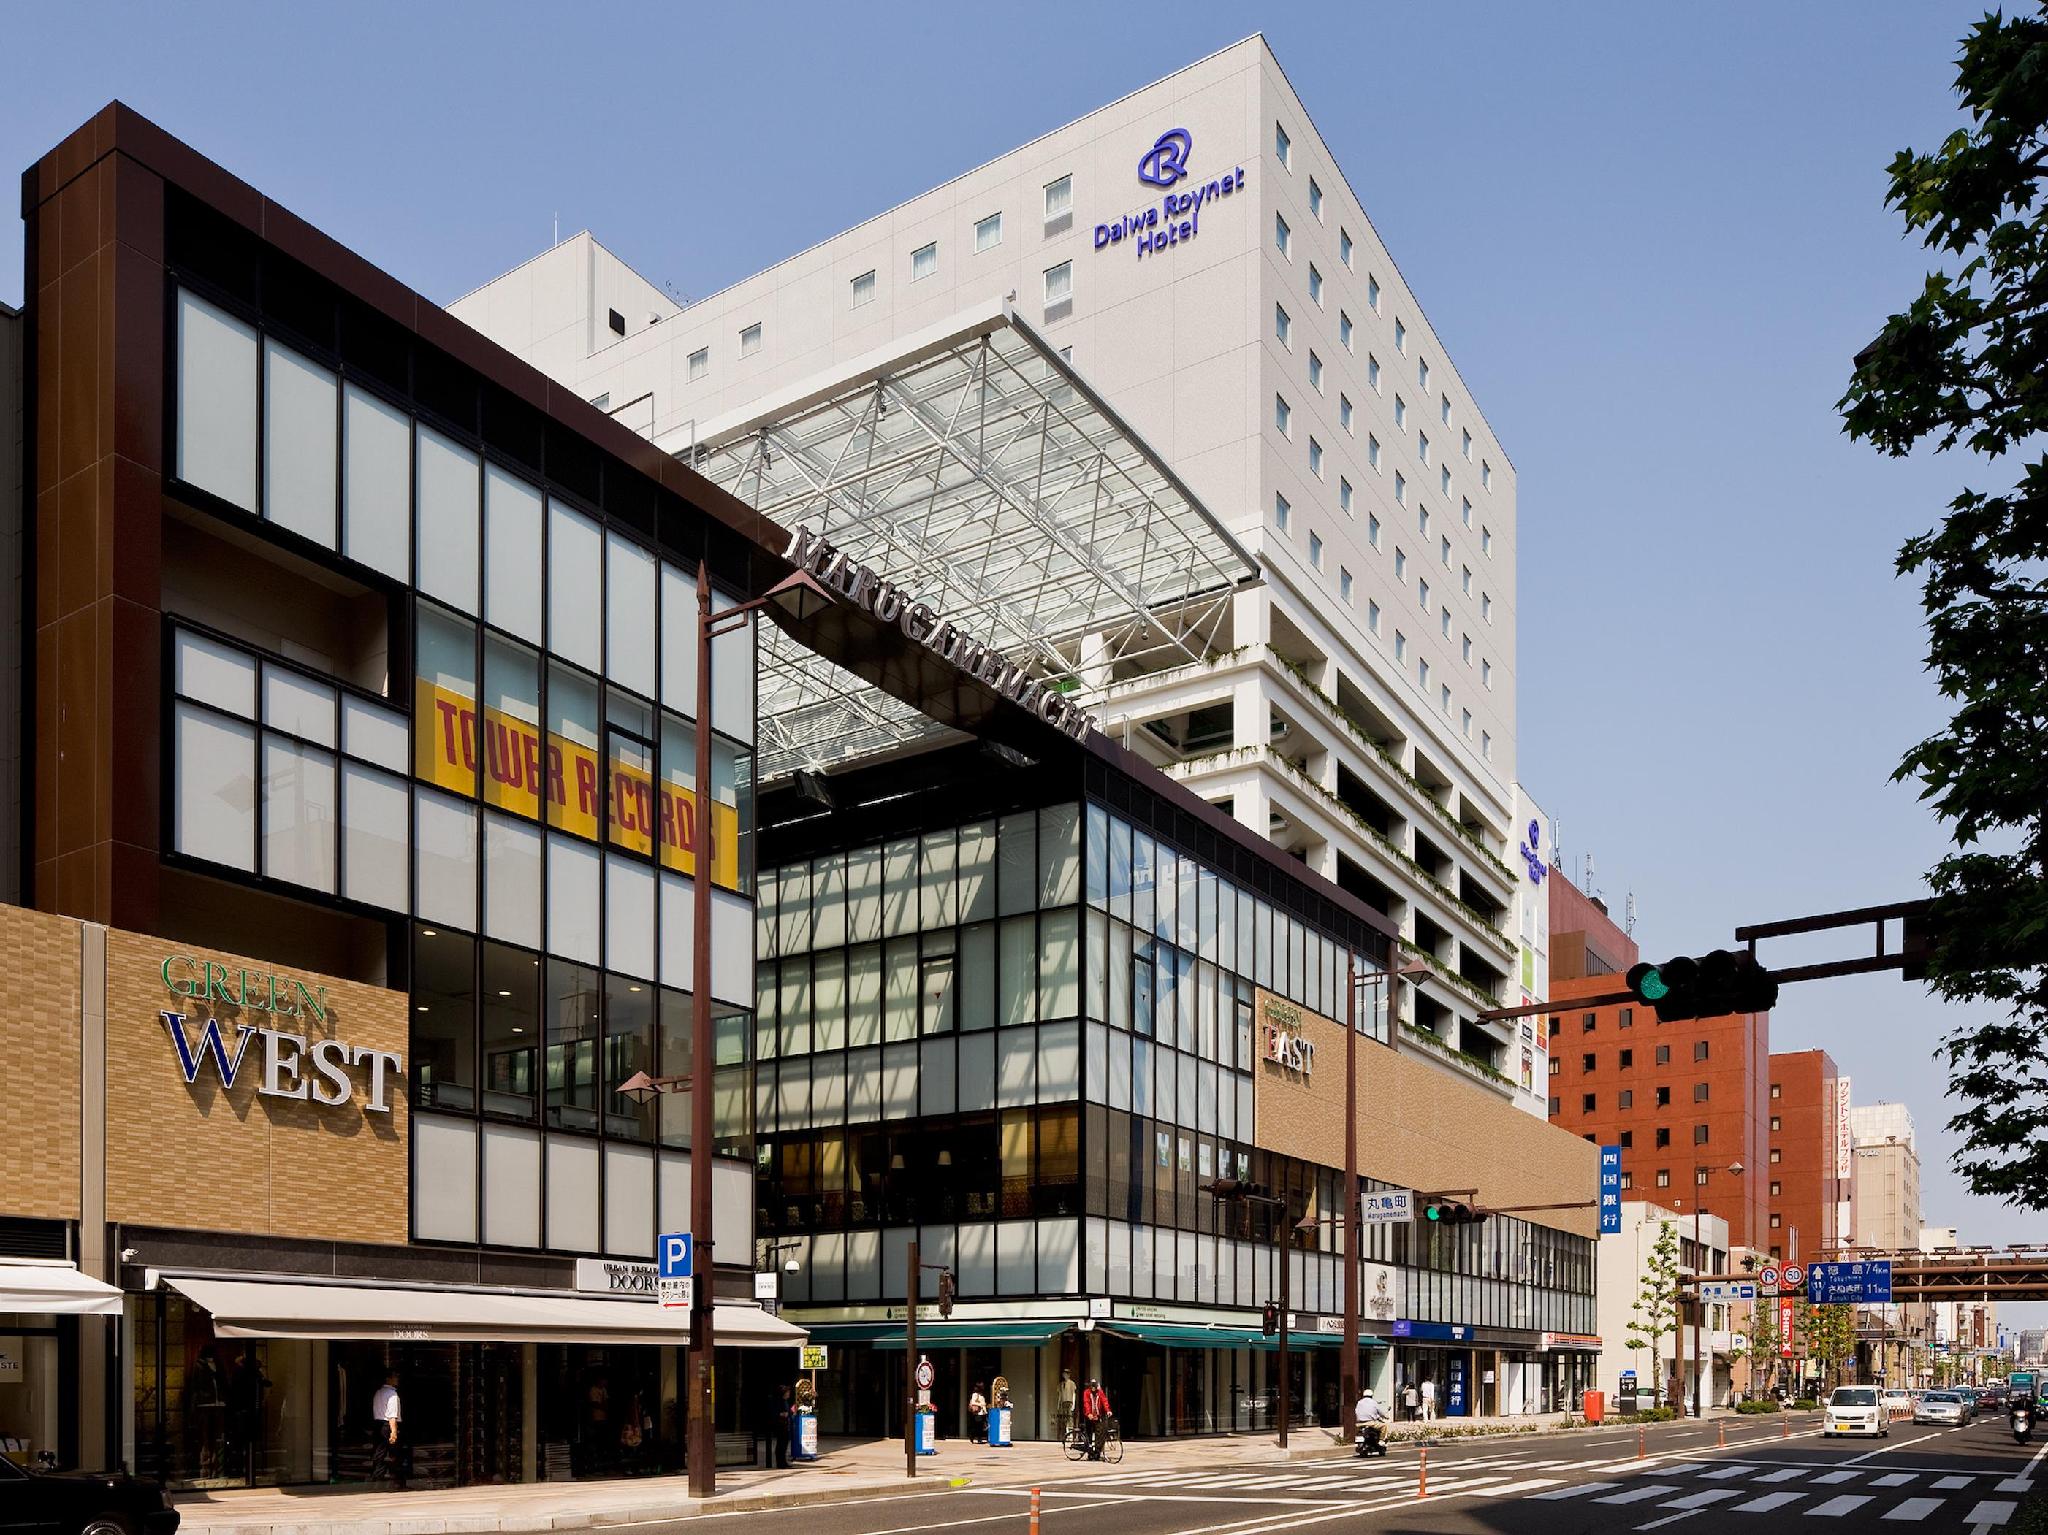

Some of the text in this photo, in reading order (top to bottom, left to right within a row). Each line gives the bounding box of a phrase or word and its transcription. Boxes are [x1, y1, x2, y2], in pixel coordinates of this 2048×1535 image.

[1094, 166, 1245, 249] Daiwa Roynet
[1137, 212, 1198, 257] Hotel
[782, 525, 1096, 745] MARUGAMEMACHI
[436, 698, 566, 806] TOWER
[161, 955, 328, 1021] GREEN
[160, 1010, 402, 1113] WEST
[1263, 1024, 1315, 1075] EAST
[1367, 1195, 1407, 1210] 丸亀町
[1603, 1153, 1618, 1227] 四国銀行
[667, 1238, 687, 1274] P
[1787, 1270, 1800, 1280] 50
[1782, 1308, 1791, 1352] SHIDAX
